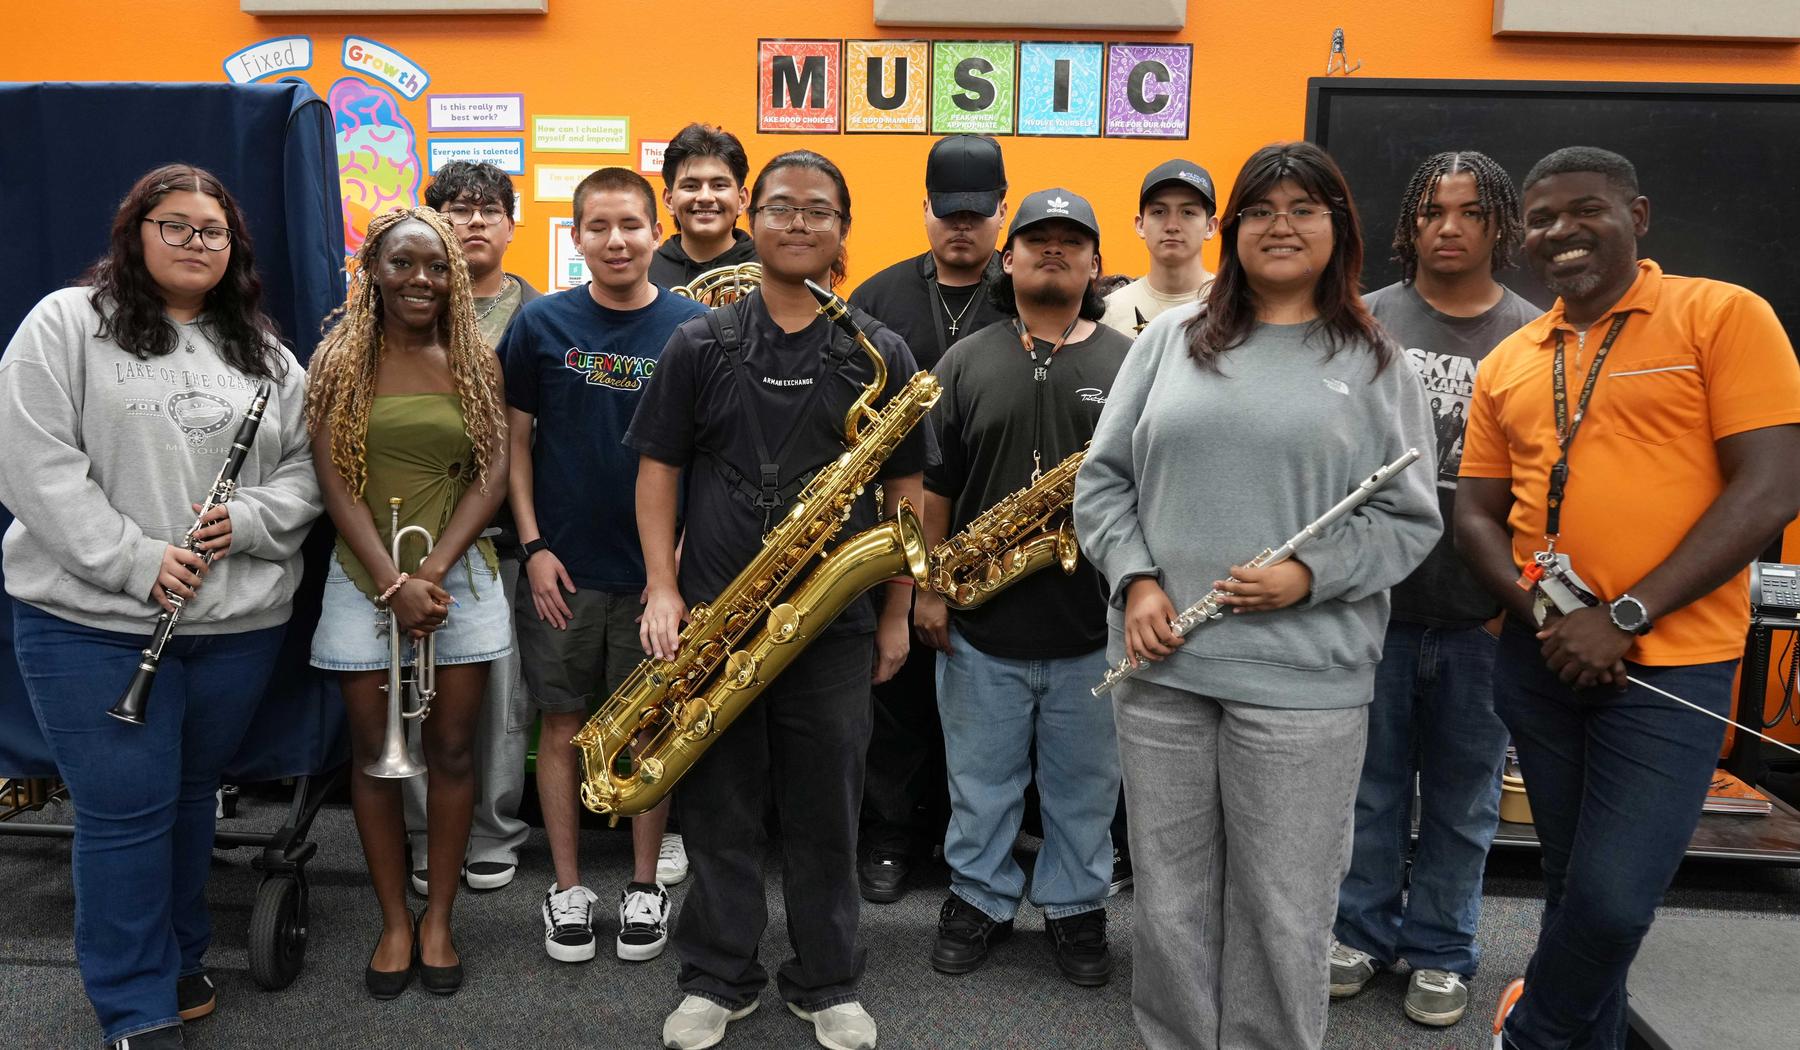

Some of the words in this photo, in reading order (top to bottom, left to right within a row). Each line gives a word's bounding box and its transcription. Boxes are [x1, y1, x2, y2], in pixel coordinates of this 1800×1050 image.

[240, 42, 295, 78] Fixed
[349, 45, 419, 93] Growth
[440, 103, 448, 111] Is
[450, 103, 466, 111] this
[469, 103, 493, 112] really
[802, 116, 835, 124] CHOICES
[537, 125, 555, 133] How
[581, 125, 623, 134] challenge
[537, 134, 566, 143] myself
[586, 135, 624, 143] improve?
[432, 148, 471, 157] Everyone
[483, 147, 519, 155] talented
[644, 148, 663, 156] This
[1046, 207, 1069, 215] adidas
[567, 351, 655, 376] CUERNAVAC
[115, 360, 155, 385] LAKE
[160, 367, 177, 385] OF
[182, 370, 210, 388] THE
[217, 374, 261, 393] OZARK
[590, 370, 639, 388] Morelos
[783, 378, 814, 387] EXCHANGE
[166, 443, 231, 455] MISOUR
